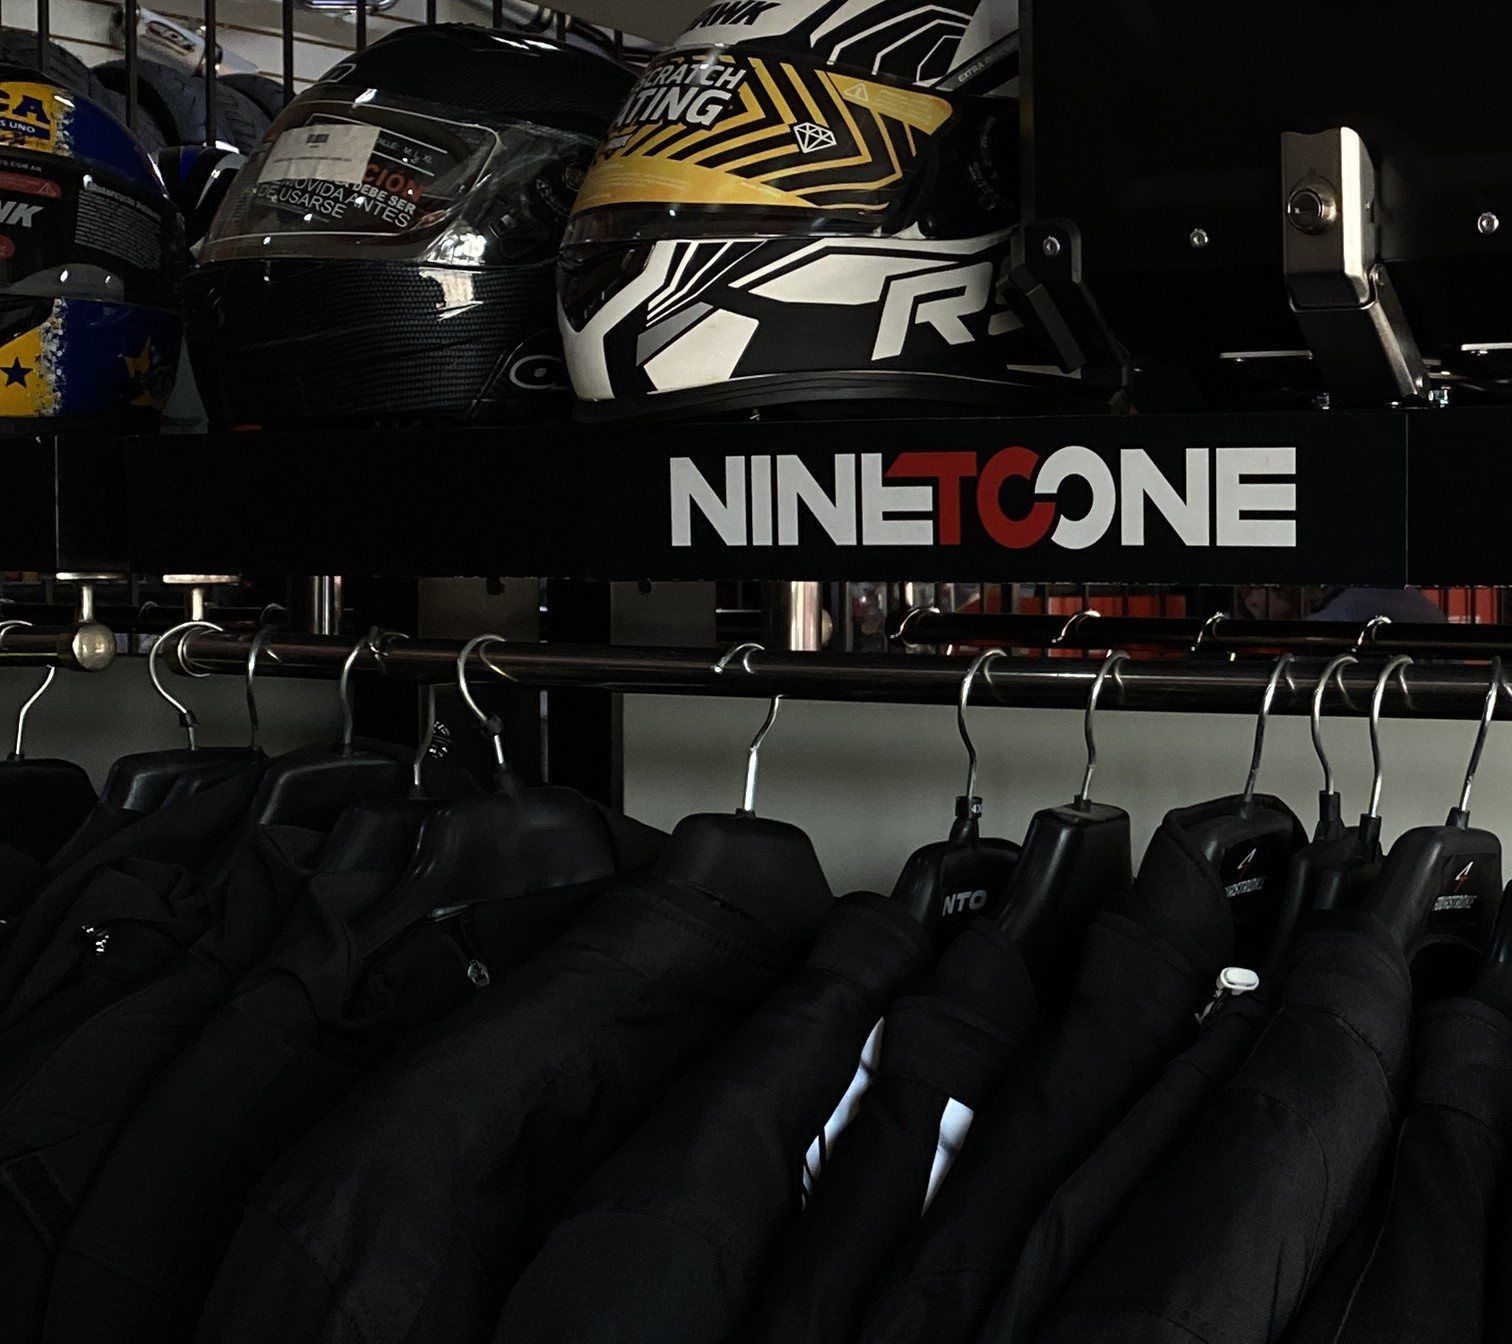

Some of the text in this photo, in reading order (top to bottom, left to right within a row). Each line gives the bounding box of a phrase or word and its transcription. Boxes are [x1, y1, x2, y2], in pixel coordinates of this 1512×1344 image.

[9, 121, 36, 134] UNO
[279, 185, 347, 219] USARSE
[345, 192, 411, 228] ANTES
[352, 182, 388, 201] DEBE
[387, 194, 417, 215] SER
